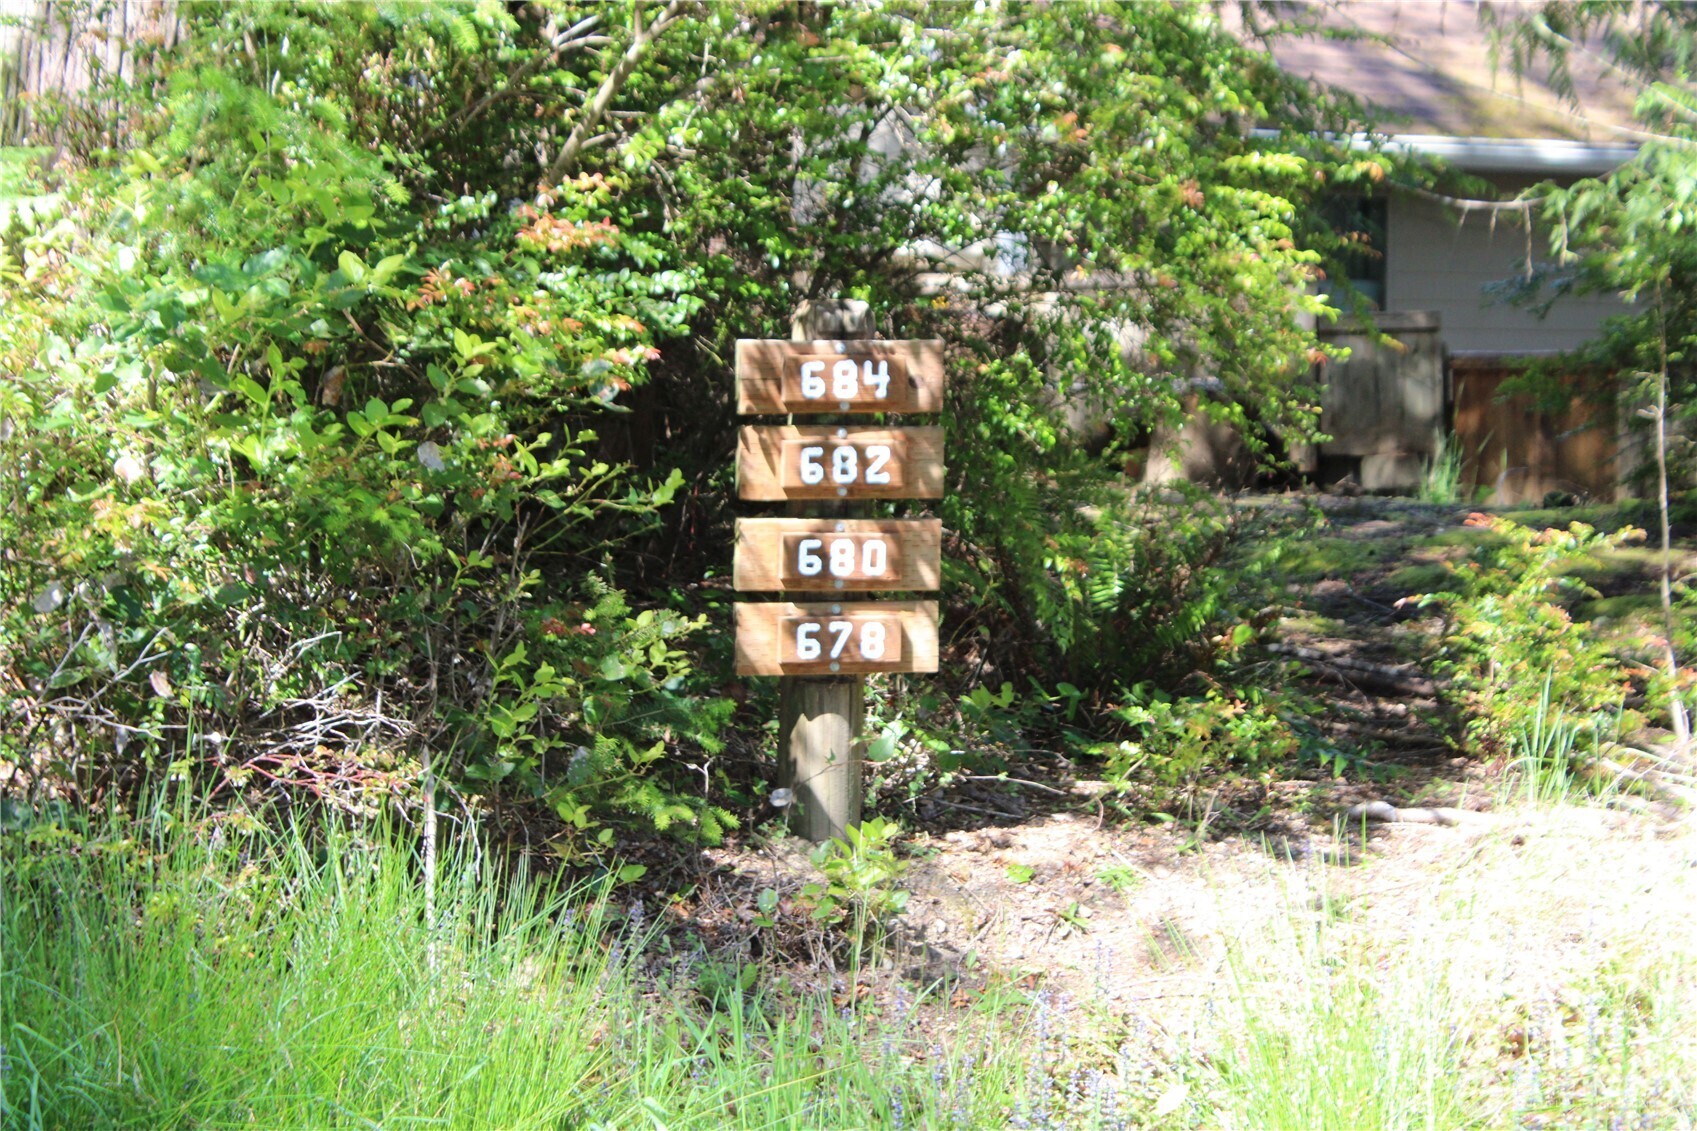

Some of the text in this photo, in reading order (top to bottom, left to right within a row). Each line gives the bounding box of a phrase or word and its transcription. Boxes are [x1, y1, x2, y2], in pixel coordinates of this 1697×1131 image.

[801, 359, 890, 399] 684
[800, 445, 891, 485] 682
[798, 538, 887, 576] 680
[796, 620, 886, 660] 678
